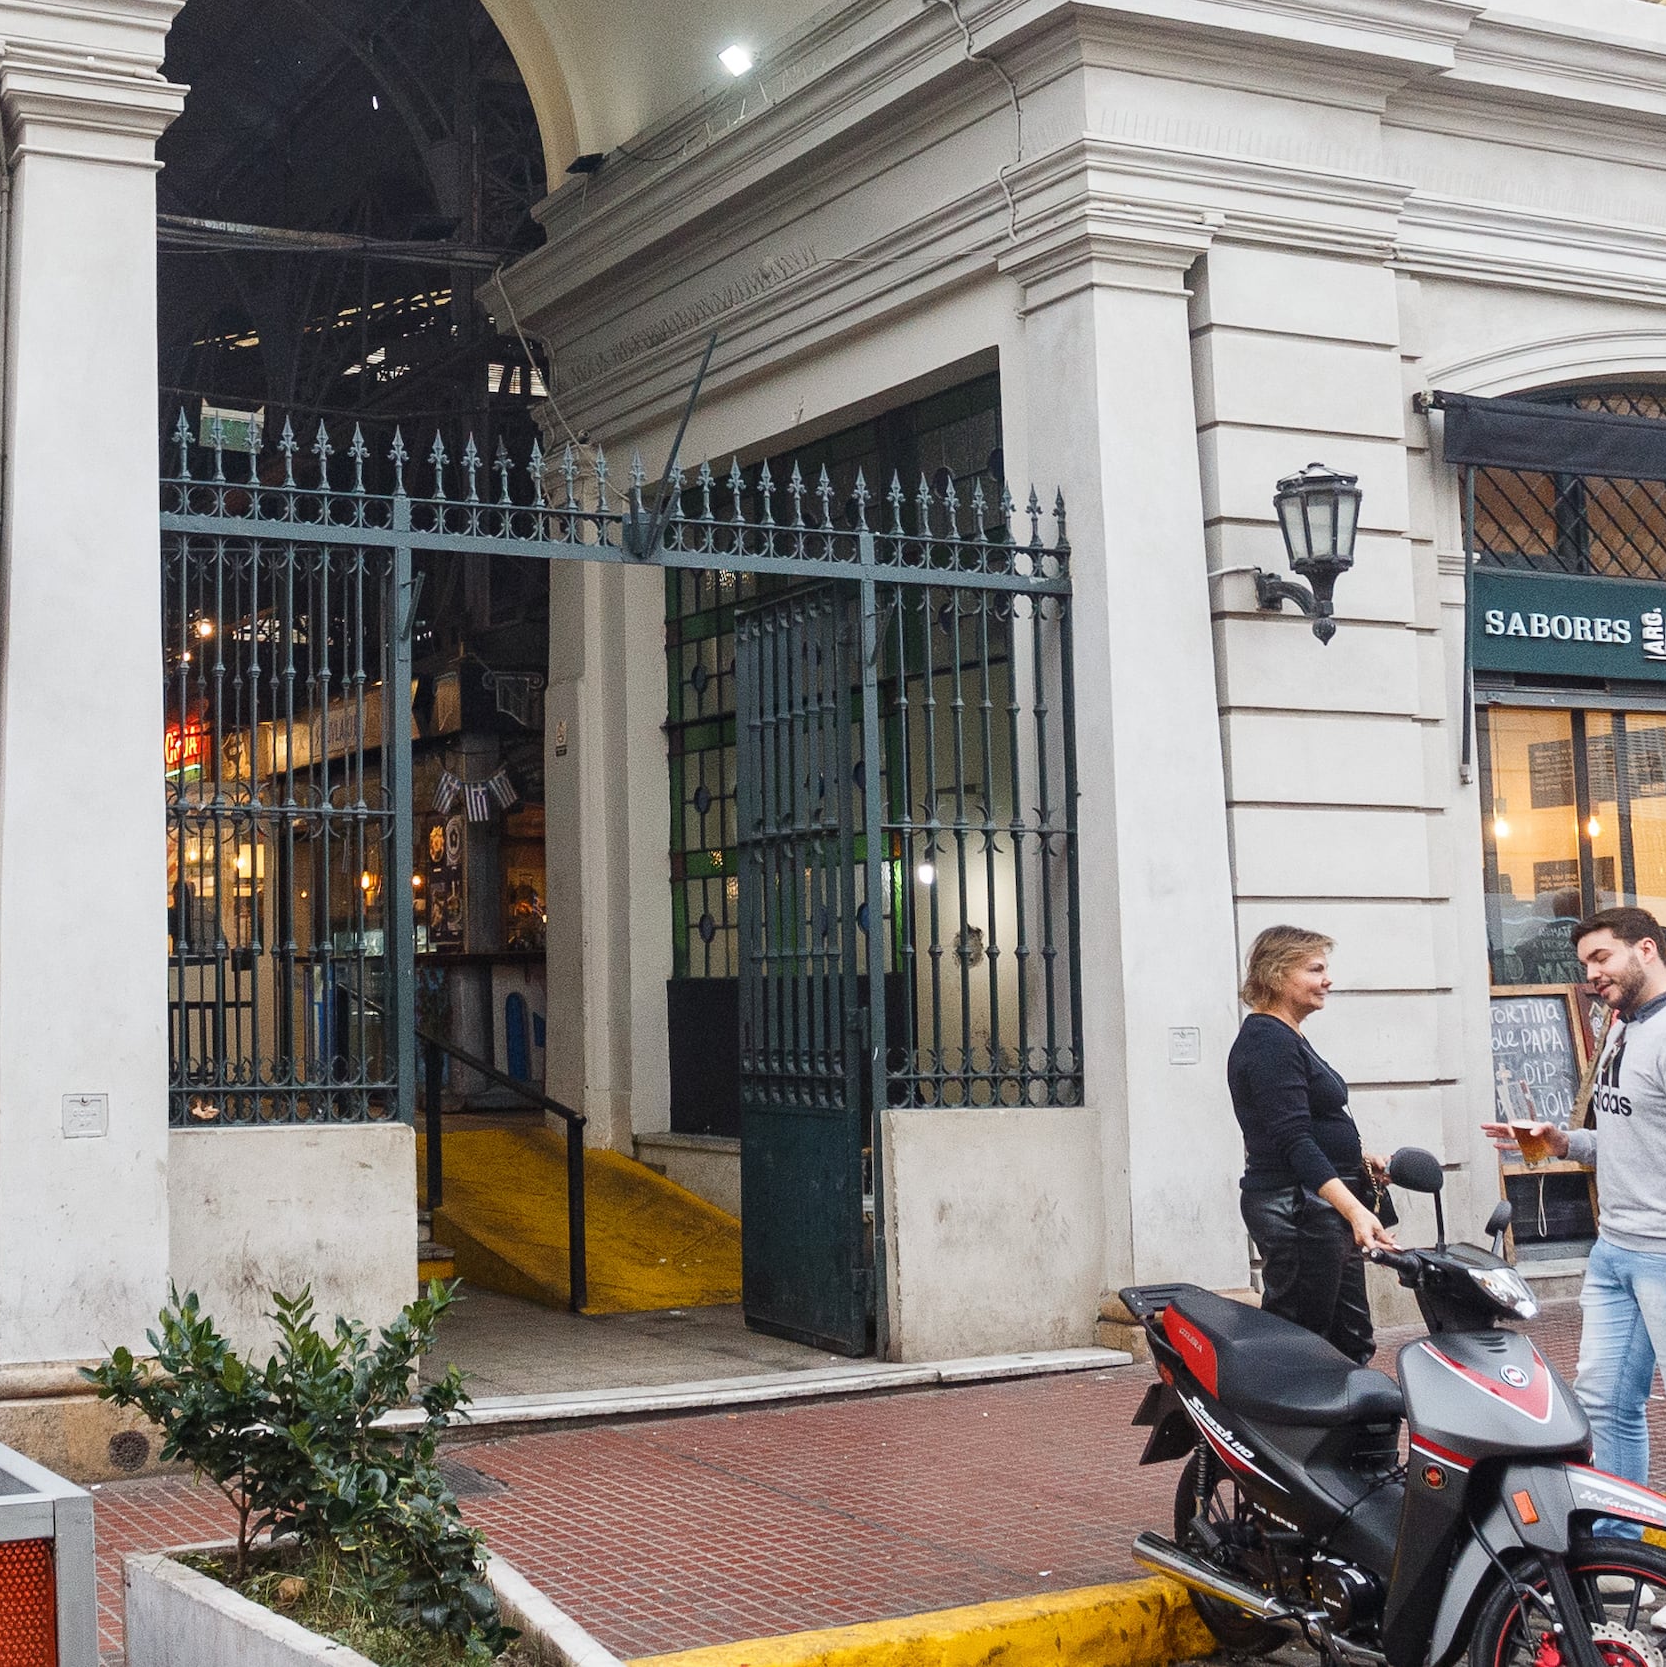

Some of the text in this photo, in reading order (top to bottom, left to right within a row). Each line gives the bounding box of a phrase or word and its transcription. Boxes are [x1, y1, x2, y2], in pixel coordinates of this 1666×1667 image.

[1485, 609, 1632, 644] SABORES
[1521, 1025, 1564, 1054] PAPA
[1593, 1084, 1632, 1117] didas
[1187, 1396, 1256, 1460] Smash 110
